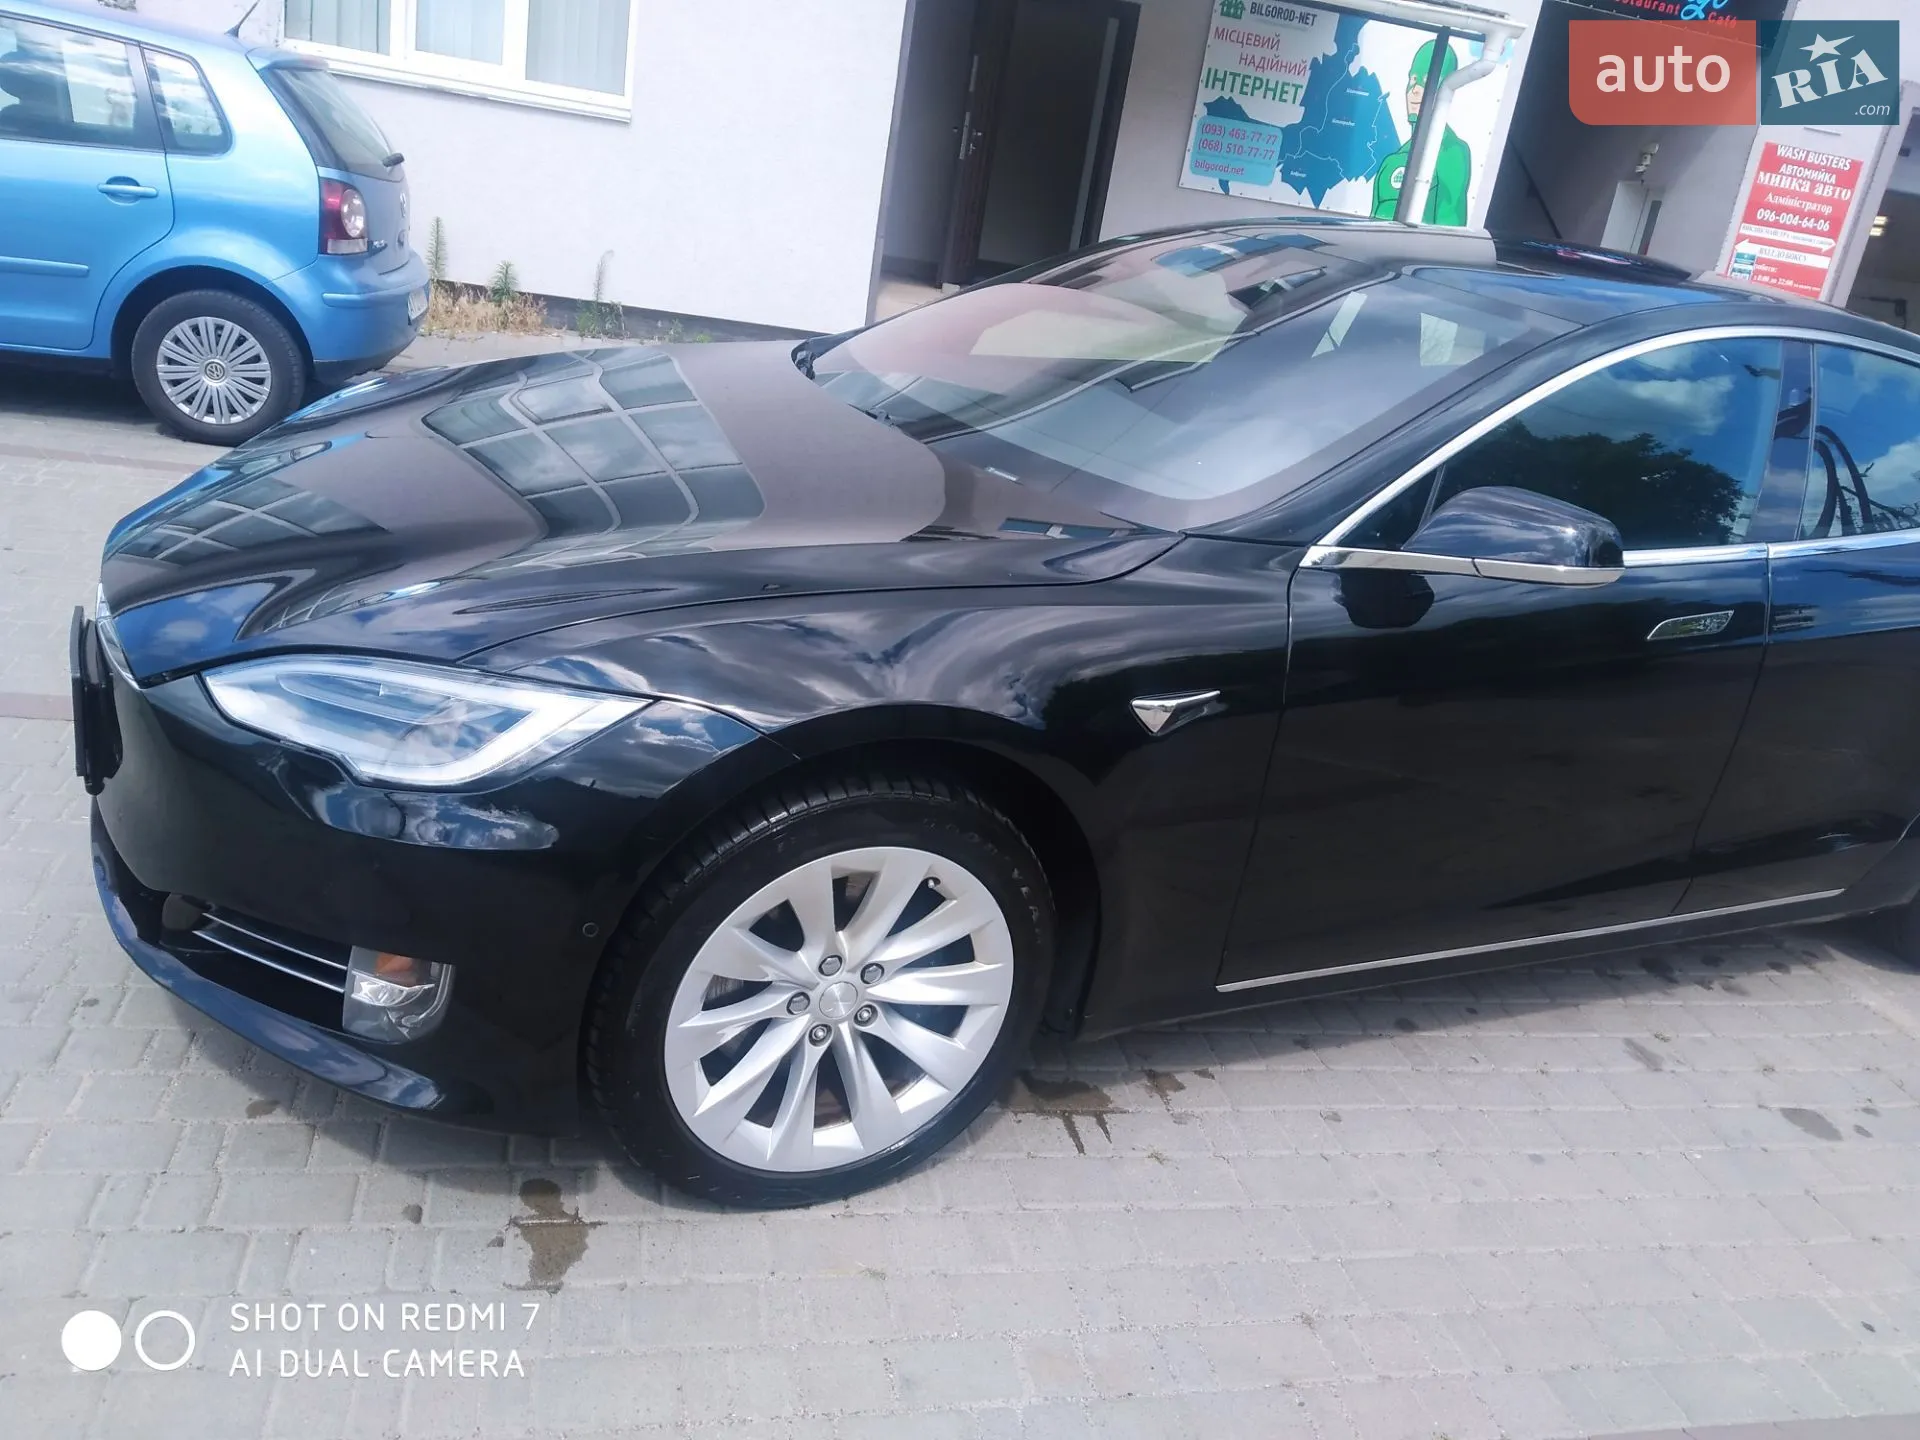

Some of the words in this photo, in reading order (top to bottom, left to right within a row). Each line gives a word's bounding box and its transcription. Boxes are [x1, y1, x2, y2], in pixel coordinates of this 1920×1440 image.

[1250, 2, 1317, 26] BILGOROD-NET
[1214, 26, 1280, 51] МІСЦЕВИЙ
[1239, 52, 1307, 76] НАДІЙНИЙ
[1204, 67, 1304, 104] ІНТЕРНЕТ
[1202, 123, 1225, 138] (093)
[1229, 127, 1277, 146] 463-77-77
[1198, 138, 1223, 153] (068)
[1226, 143, 1276, 160] 510-77-77
[1776, 144, 1807, 161] WASH
[1807, 151, 1852, 171] BUSTERS
[1194, 159, 1244, 176] bilgorod.net
[1778, 163, 1836, 184] АВТОМИЙКА
[1764, 192, 1833, 215] Адміністратор
[1757, 208, 1830, 232] 096-004-64-06
